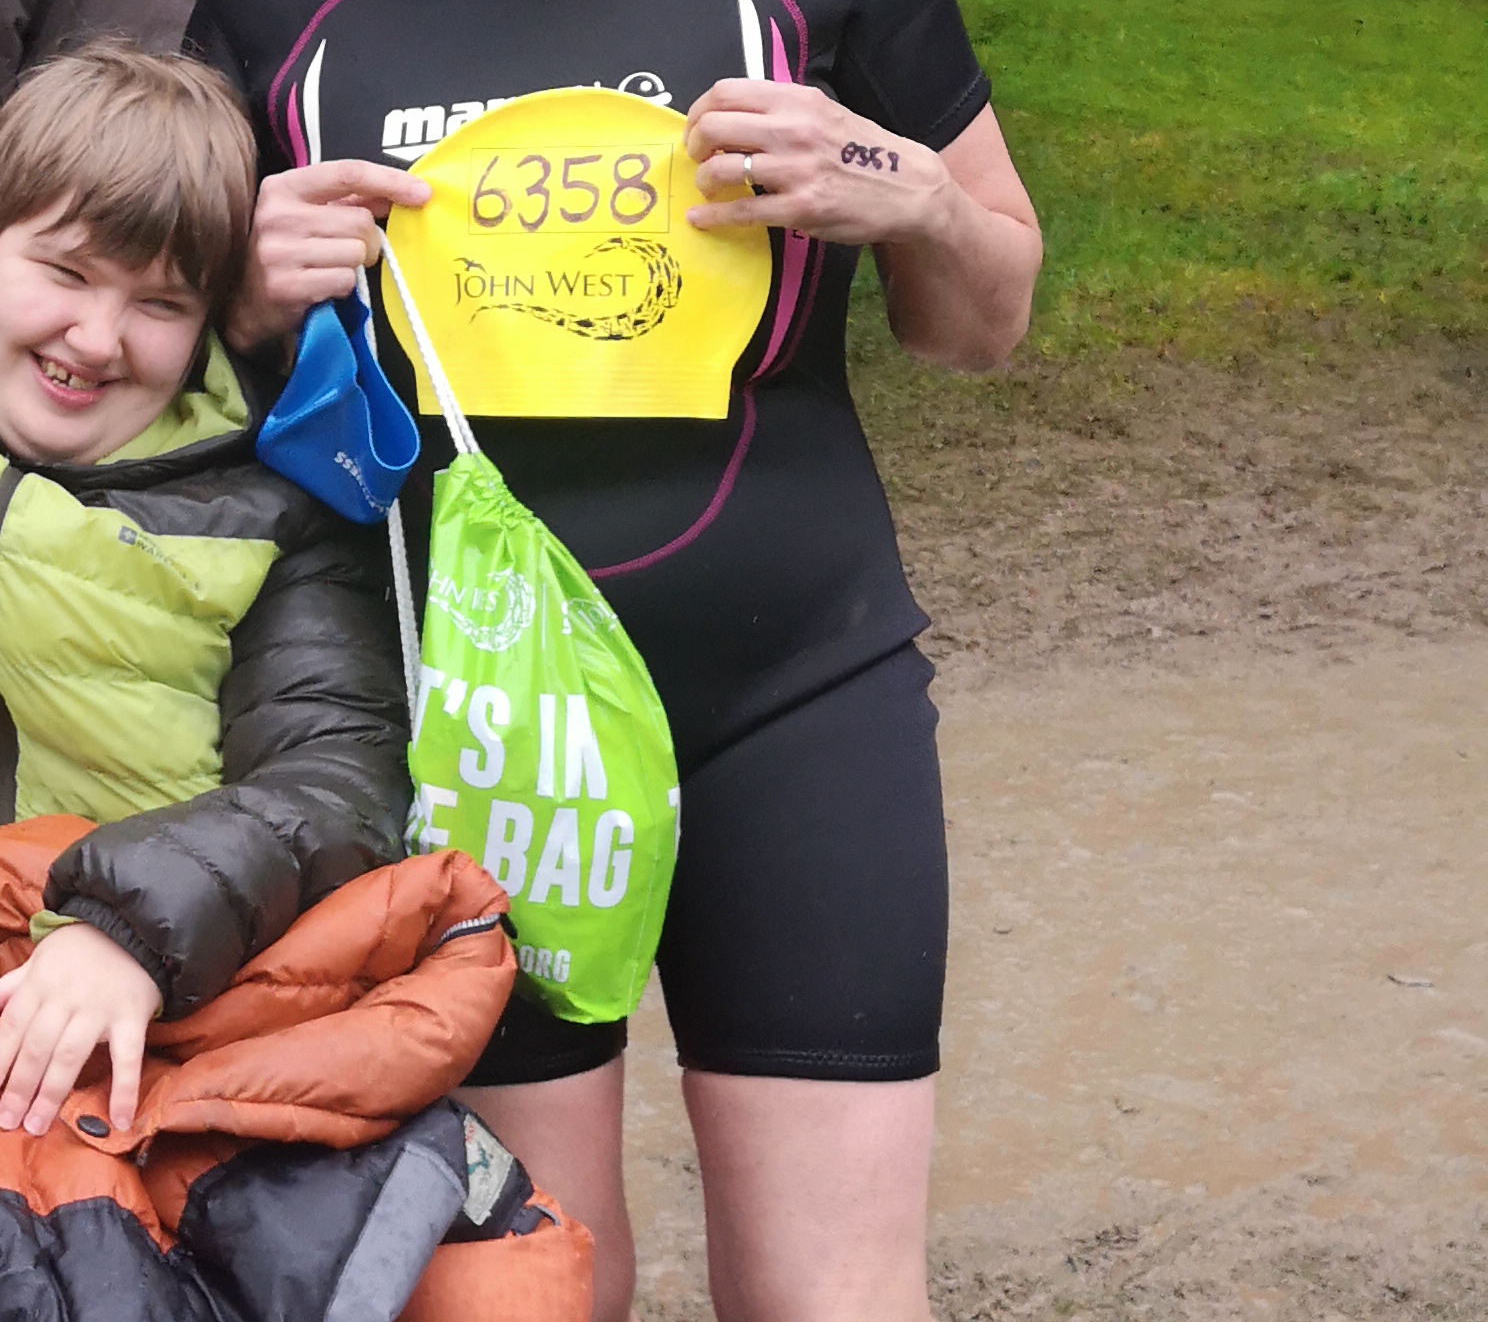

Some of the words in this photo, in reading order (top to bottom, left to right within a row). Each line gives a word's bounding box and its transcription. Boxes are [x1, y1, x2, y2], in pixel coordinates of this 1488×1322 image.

[473, 152, 659, 233] 6358
[455, 272, 534, 306] JOHN
[546, 270, 634, 298] WEST
[413, 663, 511, 789] T'S
[536, 694, 608, 800] IN
[483, 799, 635, 909] BAG
[518, 944, 572, 984] ORG
